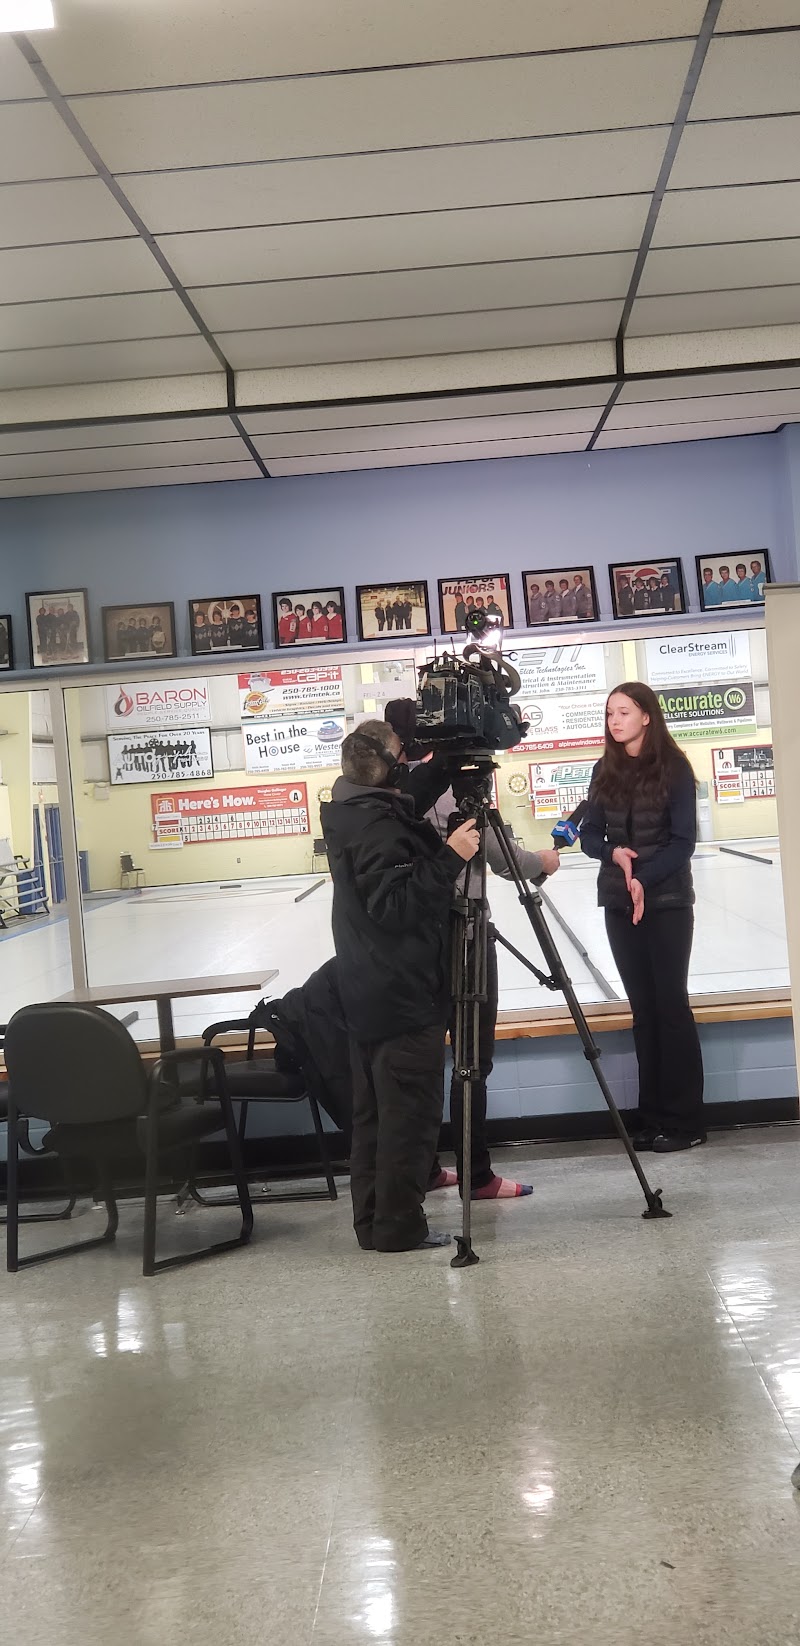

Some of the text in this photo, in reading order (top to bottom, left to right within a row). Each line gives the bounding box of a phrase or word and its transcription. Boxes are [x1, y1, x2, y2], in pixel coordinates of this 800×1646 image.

[442, 582, 495, 595] JUNIORS
[660, 642, 727, 654] ClearStream
[283, 685, 340, 694] 250-785-1000
[136, 688, 207, 705] BARON
[283, 692, 340, 700] www.trimtek.ca
[659, 692, 722, 712] Accurate
[146, 713, 200, 723] 250-785-2511
[664, 709, 724, 719] ELLSITE SOLUTIONS
[246, 724, 307, 745] Best in the
[558, 739, 605, 748] alpinewindows.c
[151, 770, 212, 779] 250-785-4868
[561, 766, 592, 778] PET
[178, 797, 220, 810] Here's
[222, 795, 256, 808] How.
[294, 793, 298, 801] A
